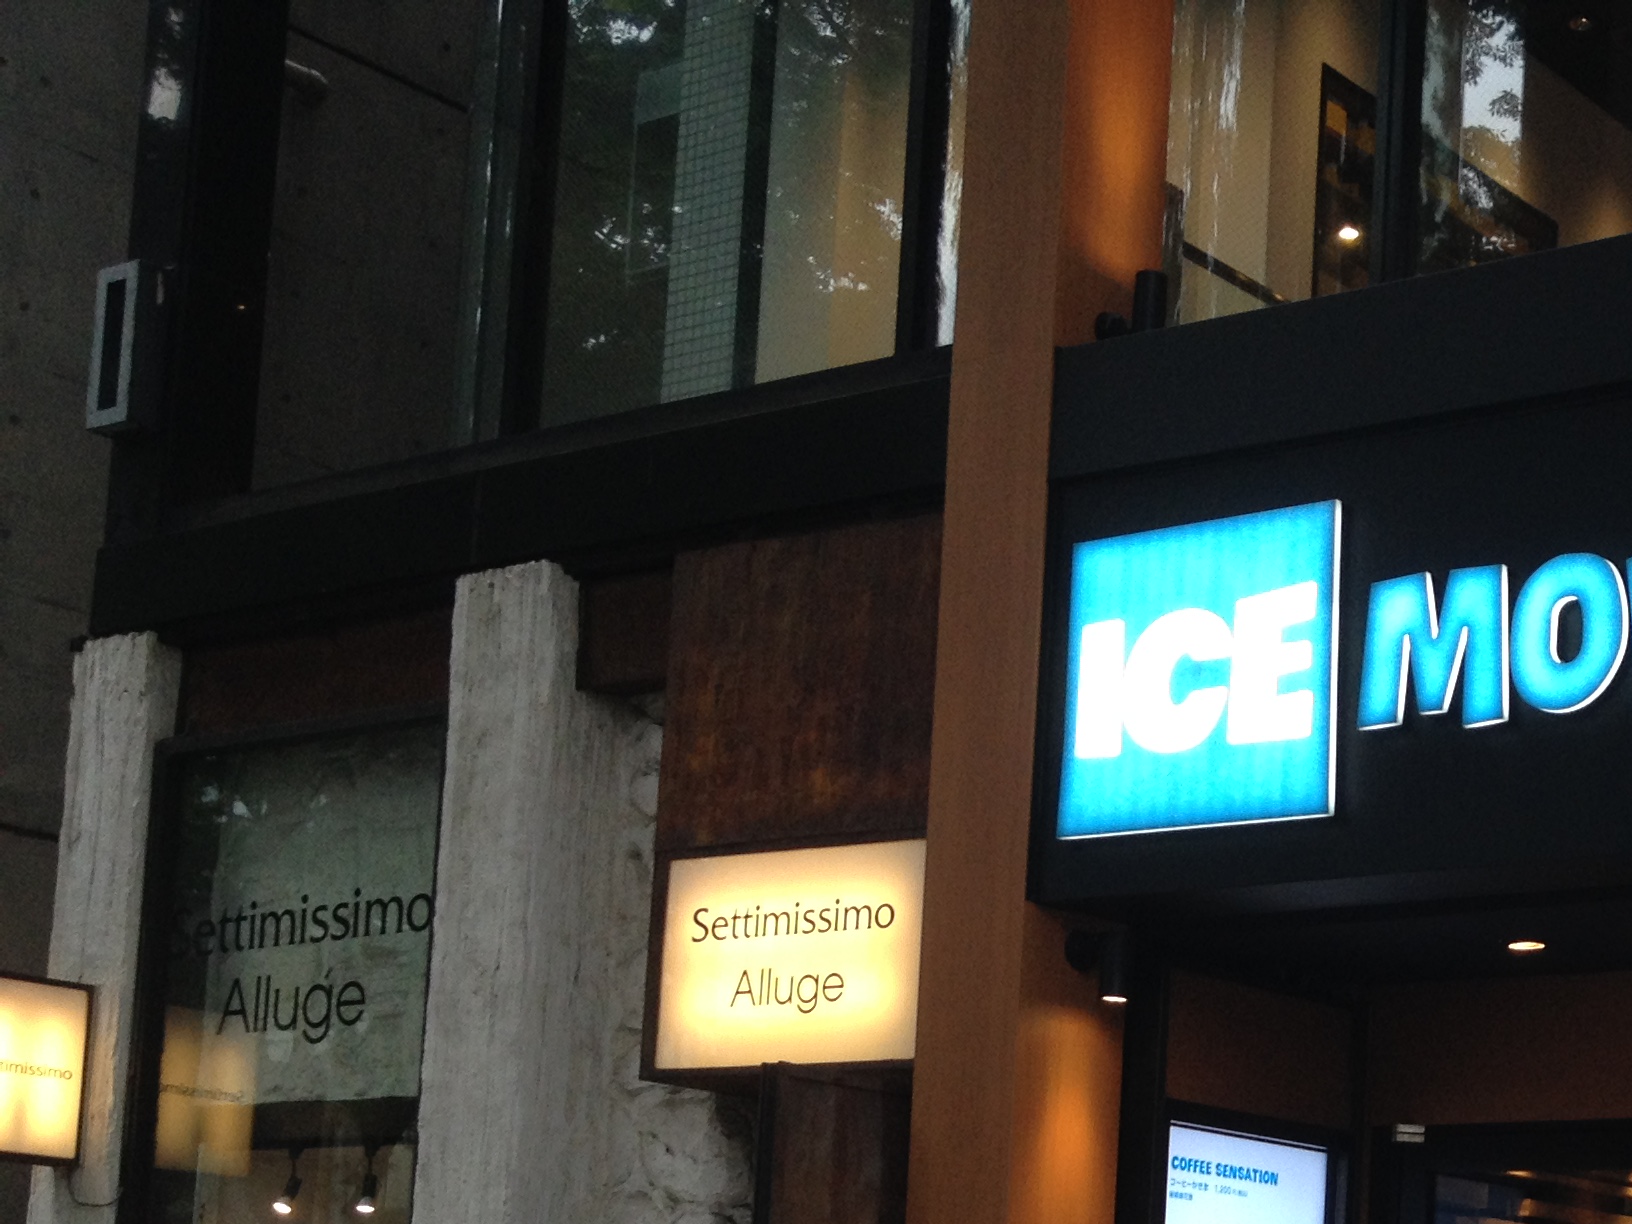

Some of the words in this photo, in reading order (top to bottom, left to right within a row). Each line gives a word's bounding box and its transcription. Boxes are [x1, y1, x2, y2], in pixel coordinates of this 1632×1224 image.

[1074, 580, 1318, 760] ICE
[691, 898, 895, 943] Settimissimo
[216, 974, 366, 1044] Alluge
[730, 967, 845, 1014] Alluge
[1171, 1156, 1211, 1174] COFFEE
[1216, 1163, 1278, 1185] SENSATION
